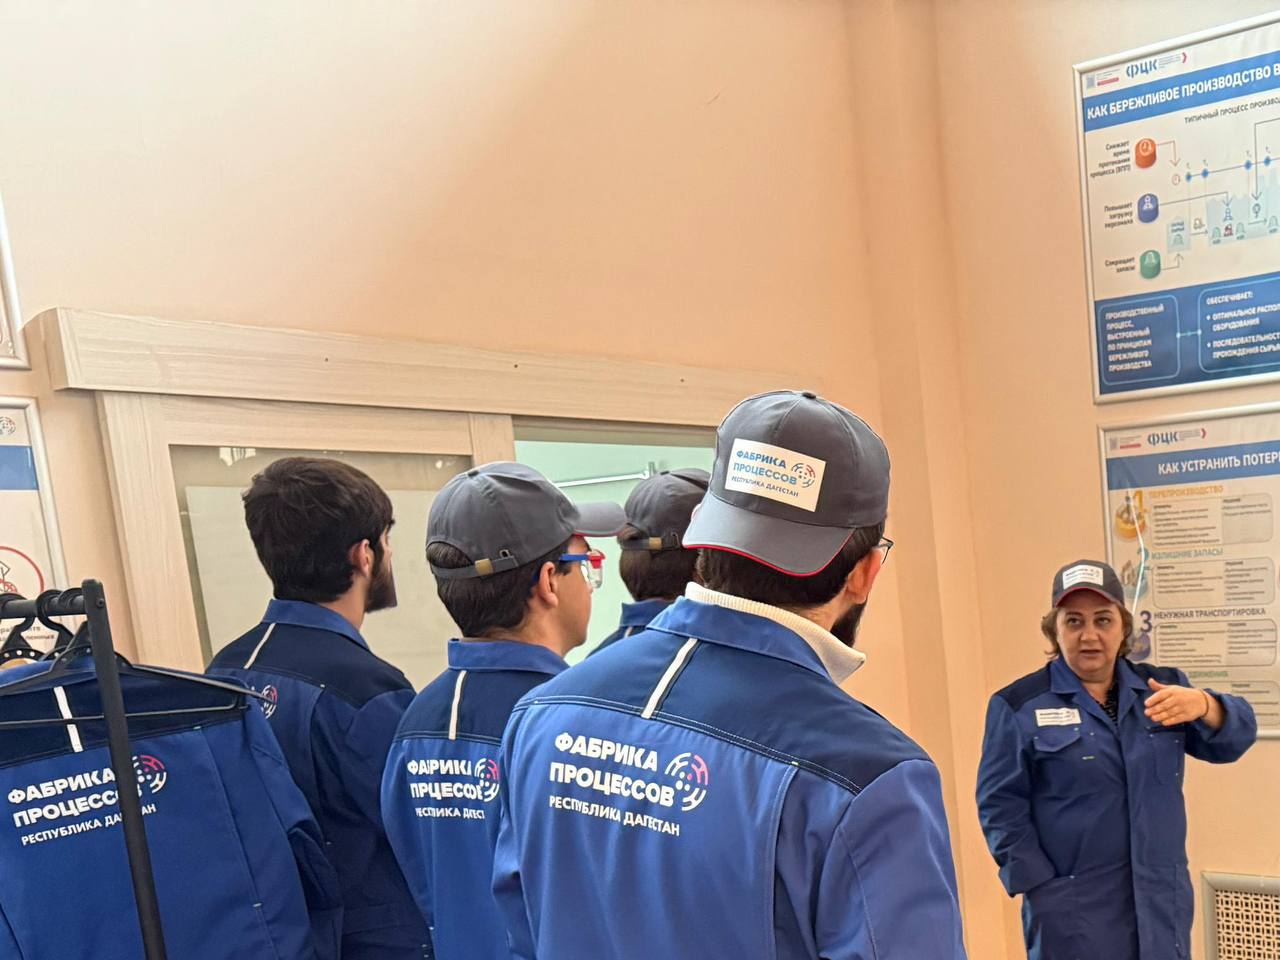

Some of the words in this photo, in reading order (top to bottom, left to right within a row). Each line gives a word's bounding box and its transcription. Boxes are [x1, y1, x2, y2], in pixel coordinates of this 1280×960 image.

[1126, 59, 1158, 78] ФЦК
[1087, 105, 1108, 120] КАК
[1109, 86, 1180, 115] БЕРЕЖЛИВОЕ
[1182, 67, 1271, 97] ПРОИЗВОДСТВО
[1184, 110, 1219, 124] ТИПИЧНЫЙ
[1220, 102, 1248, 117] ПРОЦЕСС
[1148, 431, 1179, 446] ФЦК
[736, 450, 787, 469] ФАБРИКА
[1158, 463, 1179, 475] КАК
[1181, 456, 1241, 472] УСТРАНИТЬ
[733, 462, 797, 485] ПРОЦЕССОВ
[731, 476, 765, 489] РЕСПУБЛИКА
[766, 483, 799, 497] ДАГЕСТАН
[1140, 610, 1153, 633] 3
[1154, 610, 1194, 620] НЕНУЖНАЯ
[1195, 607, 1266, 618] ТРАНСПОРТИРОВКА
[555, 732, 659, 772] ФАБРИКА
[7, 768, 117, 804] ФАБРИКА
[549, 762, 675, 807] ПРОЦЕССОВ
[549, 796, 621, 822] РЕСПУБЛИКА
[623, 811, 680, 836] ДАГЕСТАН
[21, 817, 103, 846] РЕСПУБЛИКА
